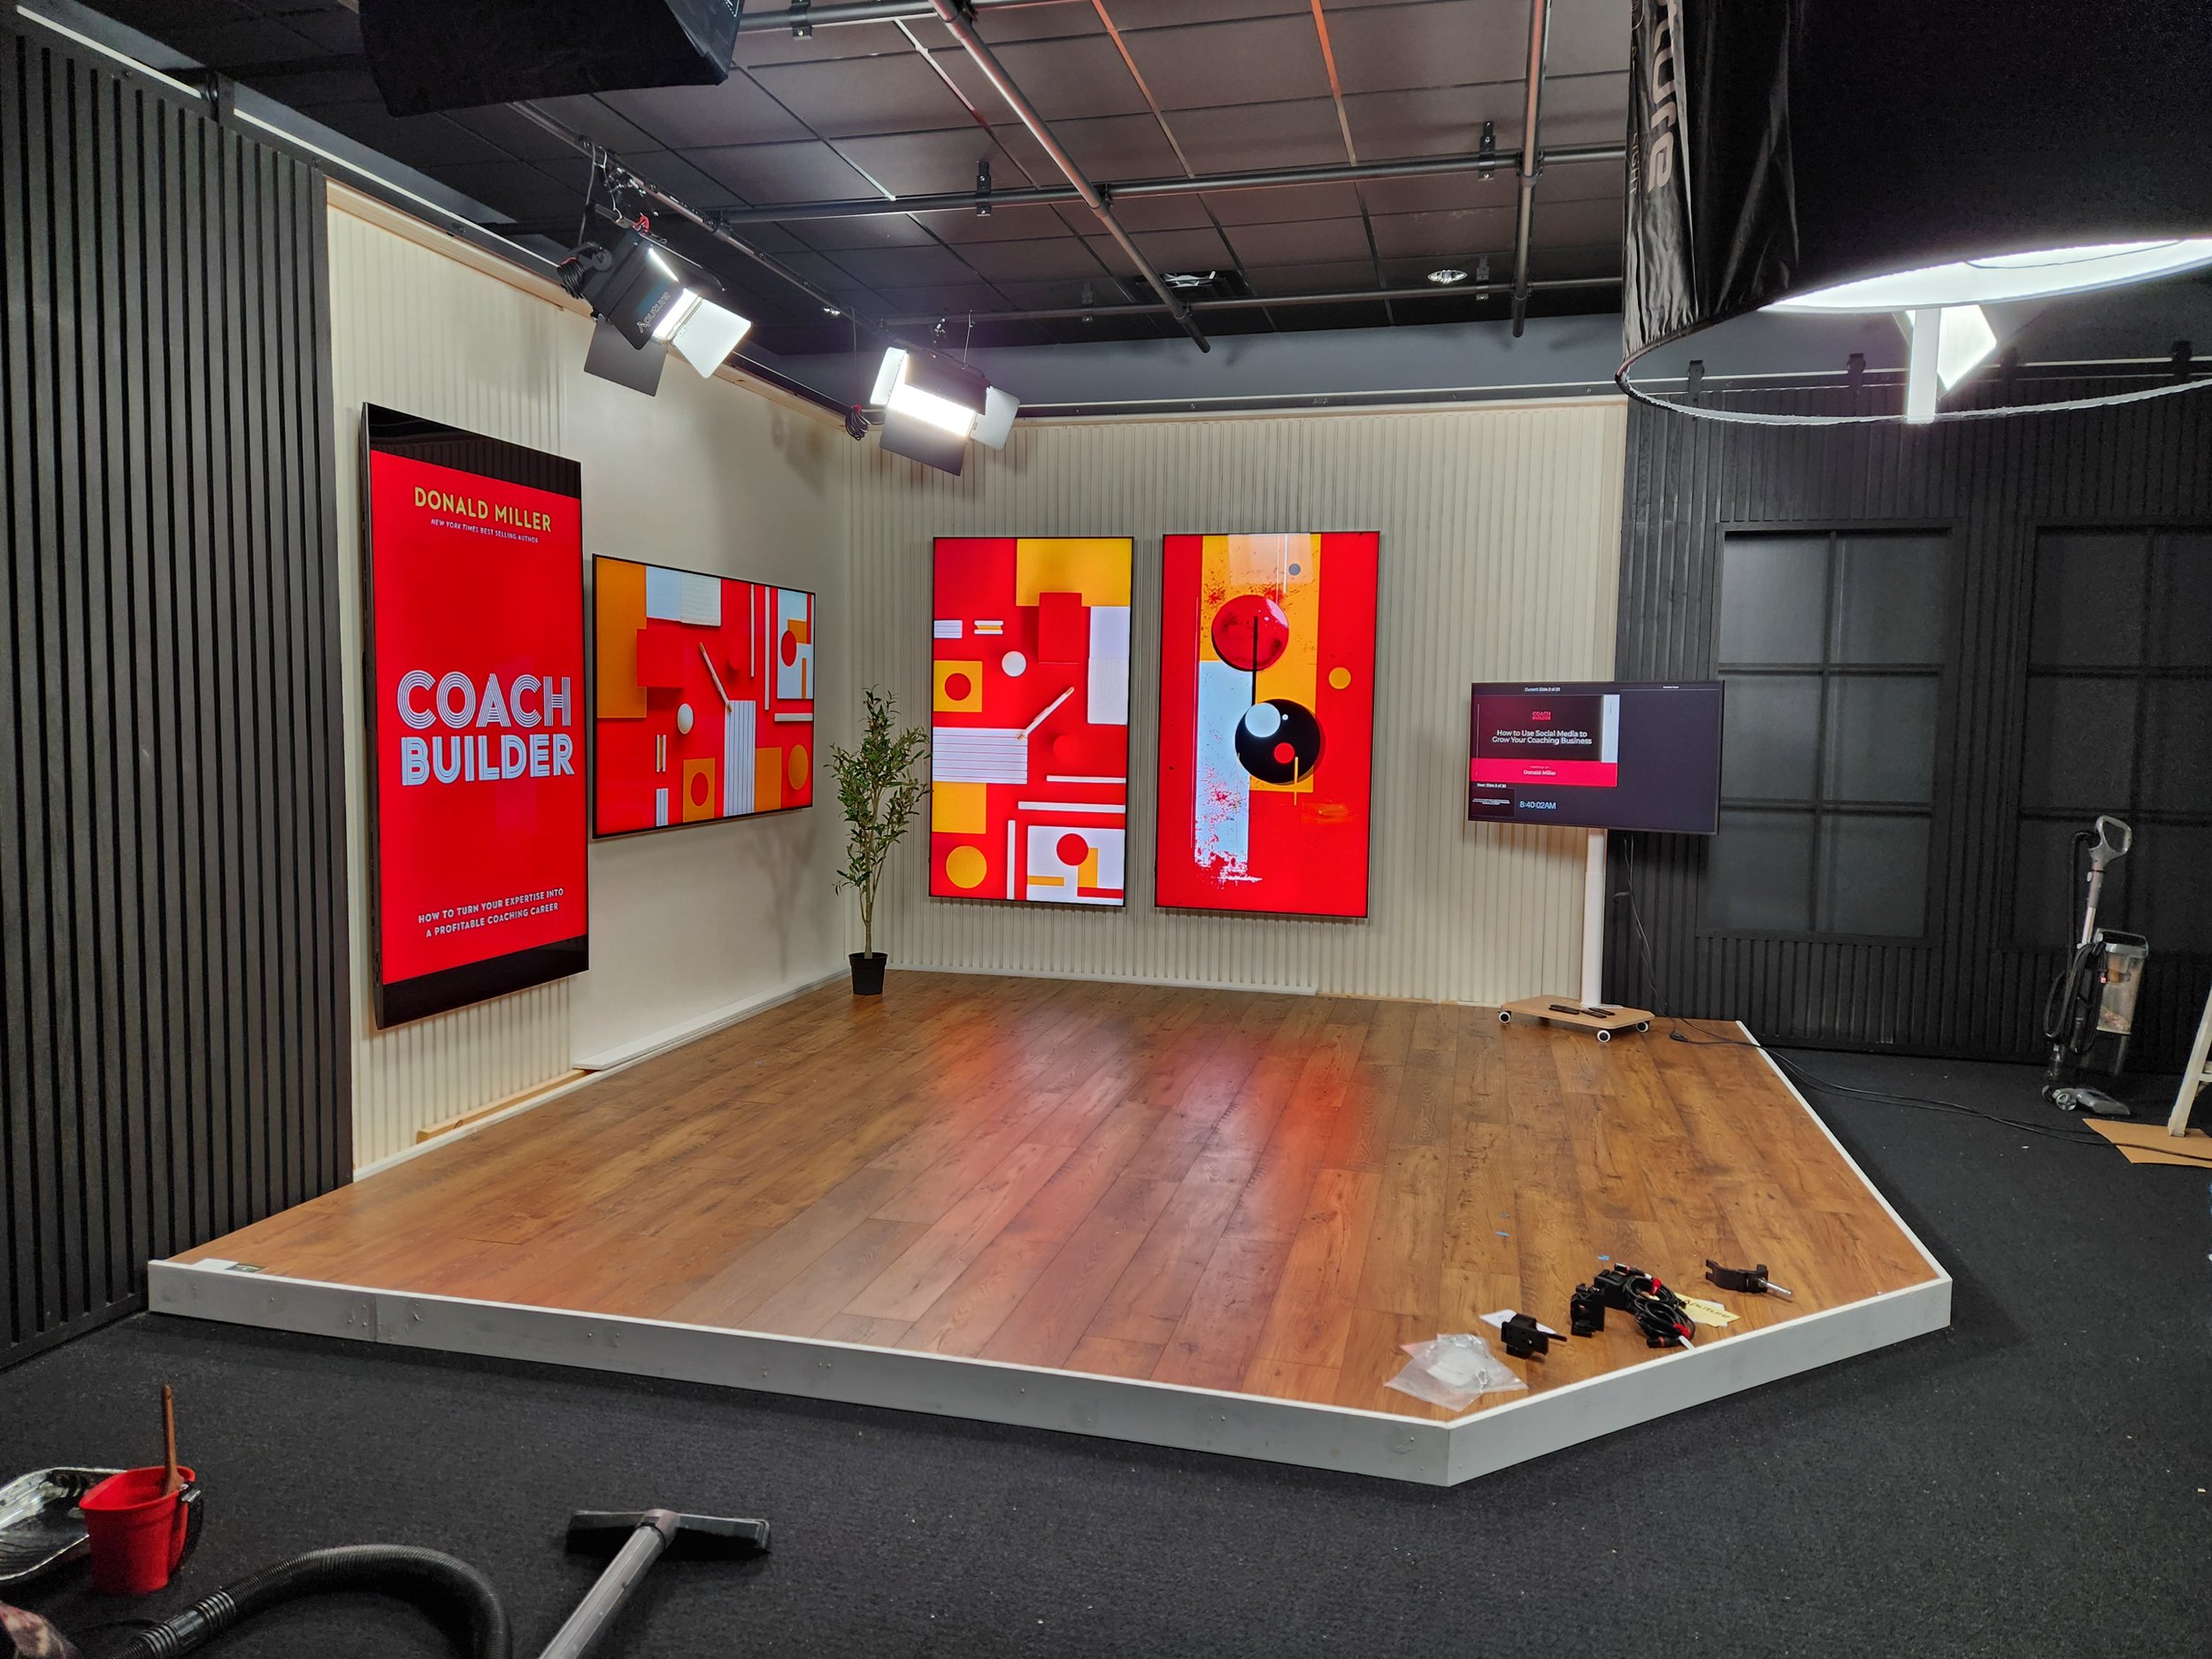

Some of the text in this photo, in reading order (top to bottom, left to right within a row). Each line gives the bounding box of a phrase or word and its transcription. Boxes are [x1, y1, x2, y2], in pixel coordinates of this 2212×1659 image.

[636, 291, 672, 334] Aputure
[414, 486, 552, 532] DONALD MILLER
[431, 518, 539, 544] NEW YORK TIMES BEST SELLING AUTHOR
[396, 669, 572, 730] COACH
[401, 733, 575, 787] BUILDER
[1527, 736, 1560, 746] Coaching
[1519, 800, 1556, 810] 8:40:02AM
[419, 887, 565, 925] HOW TO TURN YOUR EXPERTISE INTO
[426, 902, 559, 939] A PROFITABLE COACHING CAREER
